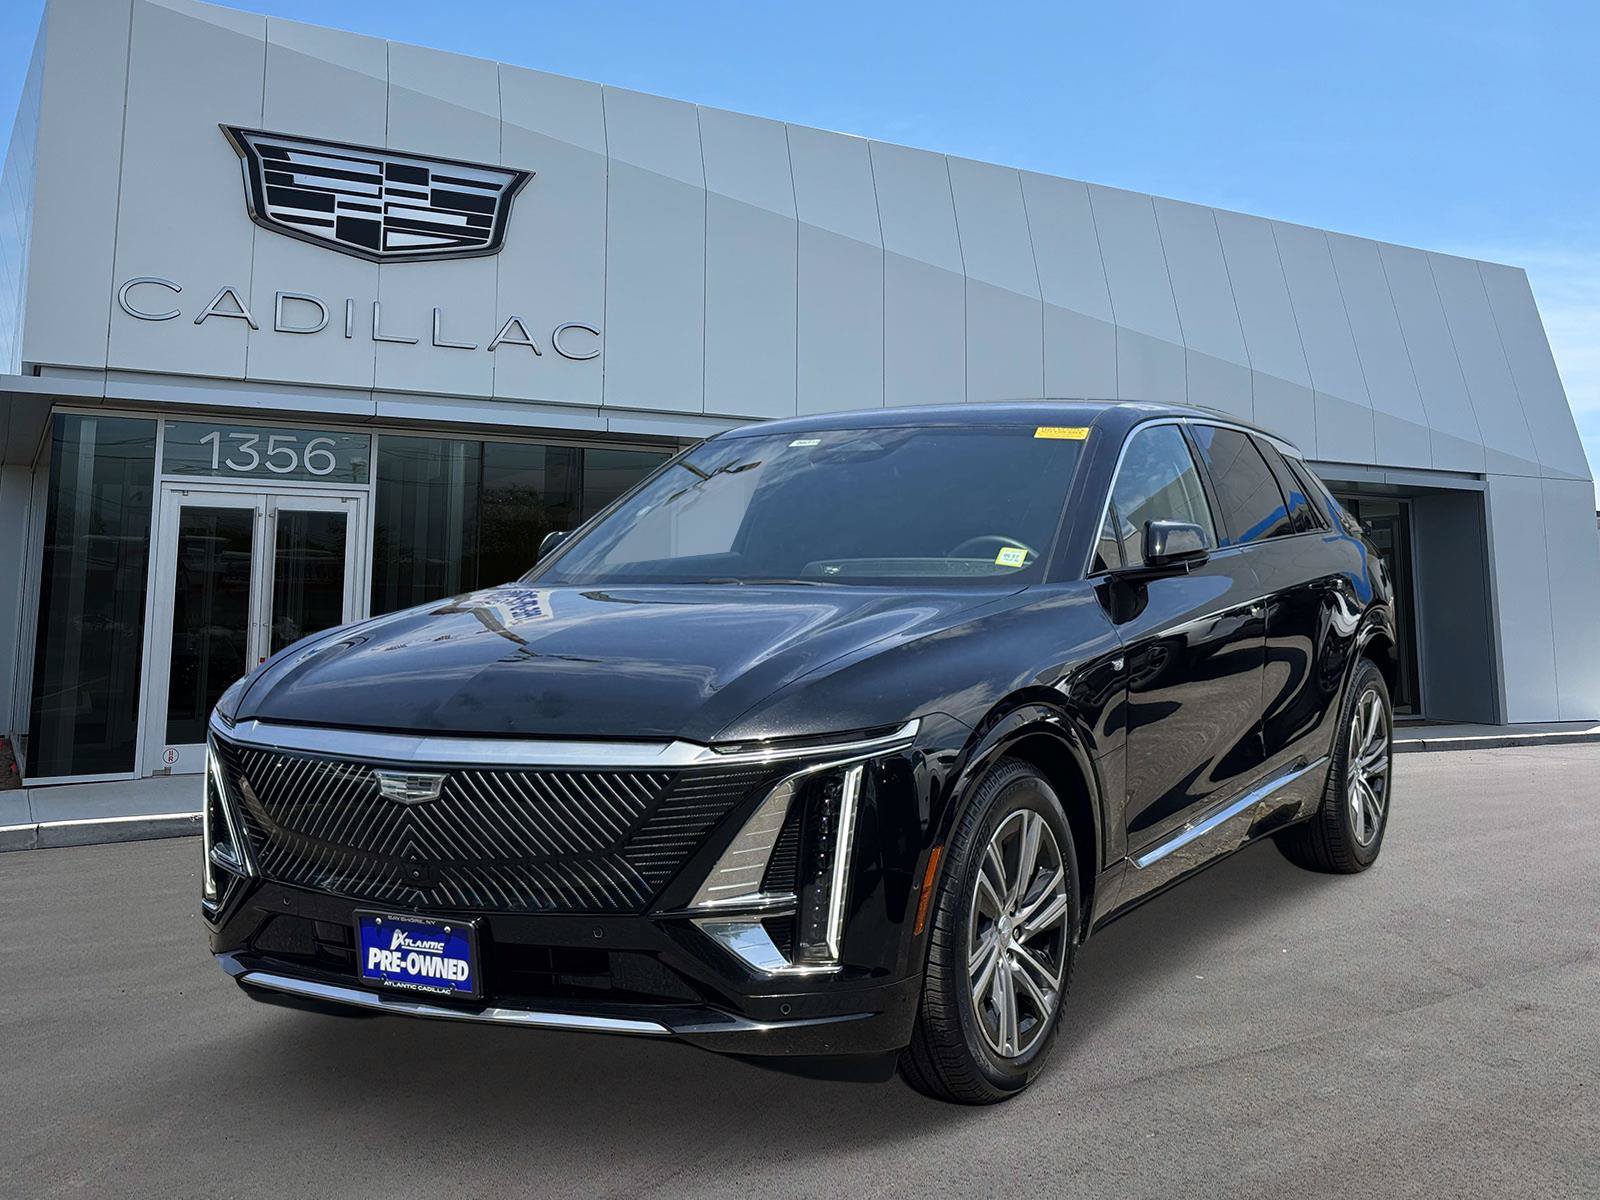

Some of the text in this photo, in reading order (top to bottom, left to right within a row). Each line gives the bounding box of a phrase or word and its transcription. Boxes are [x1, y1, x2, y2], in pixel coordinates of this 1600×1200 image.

[118, 276, 600, 361] CADILLAC
[200, 431, 336, 476] 1356
[390, 929, 445, 951] ATLANTIC
[368, 947, 469, 981] PRE-OWNED
[384, 981, 451, 995] ATLANTIC CADILLAC
